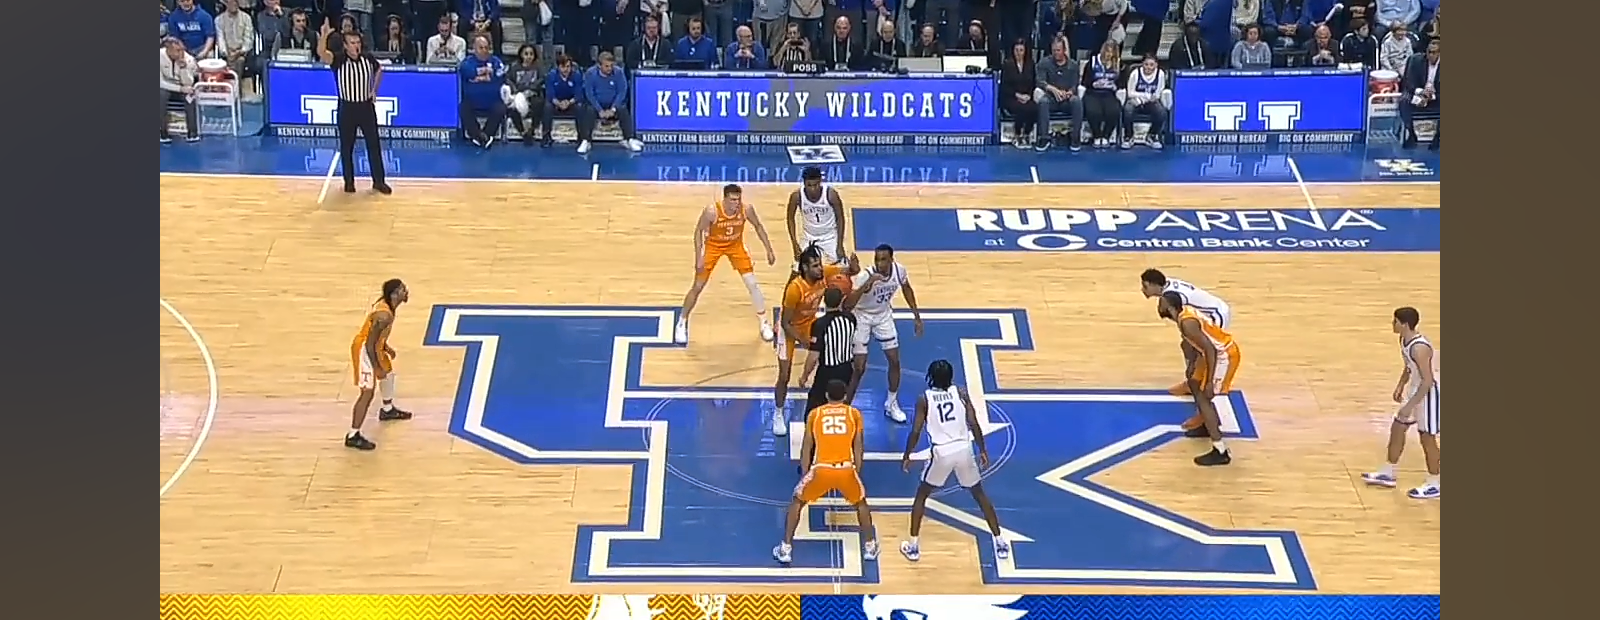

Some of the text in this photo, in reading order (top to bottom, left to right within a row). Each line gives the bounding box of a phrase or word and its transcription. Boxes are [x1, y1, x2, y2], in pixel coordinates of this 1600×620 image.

[792, 63, 818, 73] POSS
[656, 90, 974, 119] KENTUCKY WILDCATS
[277, 127, 336, 137] KENTUCKY FARM
[390, 128, 402, 139] ON
[403, 128, 450, 140] COMMITMENT
[642, 134, 726, 143] KENTUCKY FARM BUREAU
[736, 134, 807, 144] BIG ON COMMITMENT
[821, 135, 904, 144] KENTUCKY FARM BUREAU
[914, 136, 985, 145] BIG ON COMMITMENT
[1180, 134, 1267, 143] KENTUCKY FARM BUREAU
[1278, 133, 1353, 143] BIG ON COMMITMENT
[955, 208, 1387, 231] RUPP ARENA
[725, 226, 734, 235] 3
[984, 238, 1005, 247] at
[1096, 237, 1370, 248] Central Bank Center
[876, 292, 892, 304] 33
[936, 401, 956, 423] 12
[821, 415, 847, 435] 25
